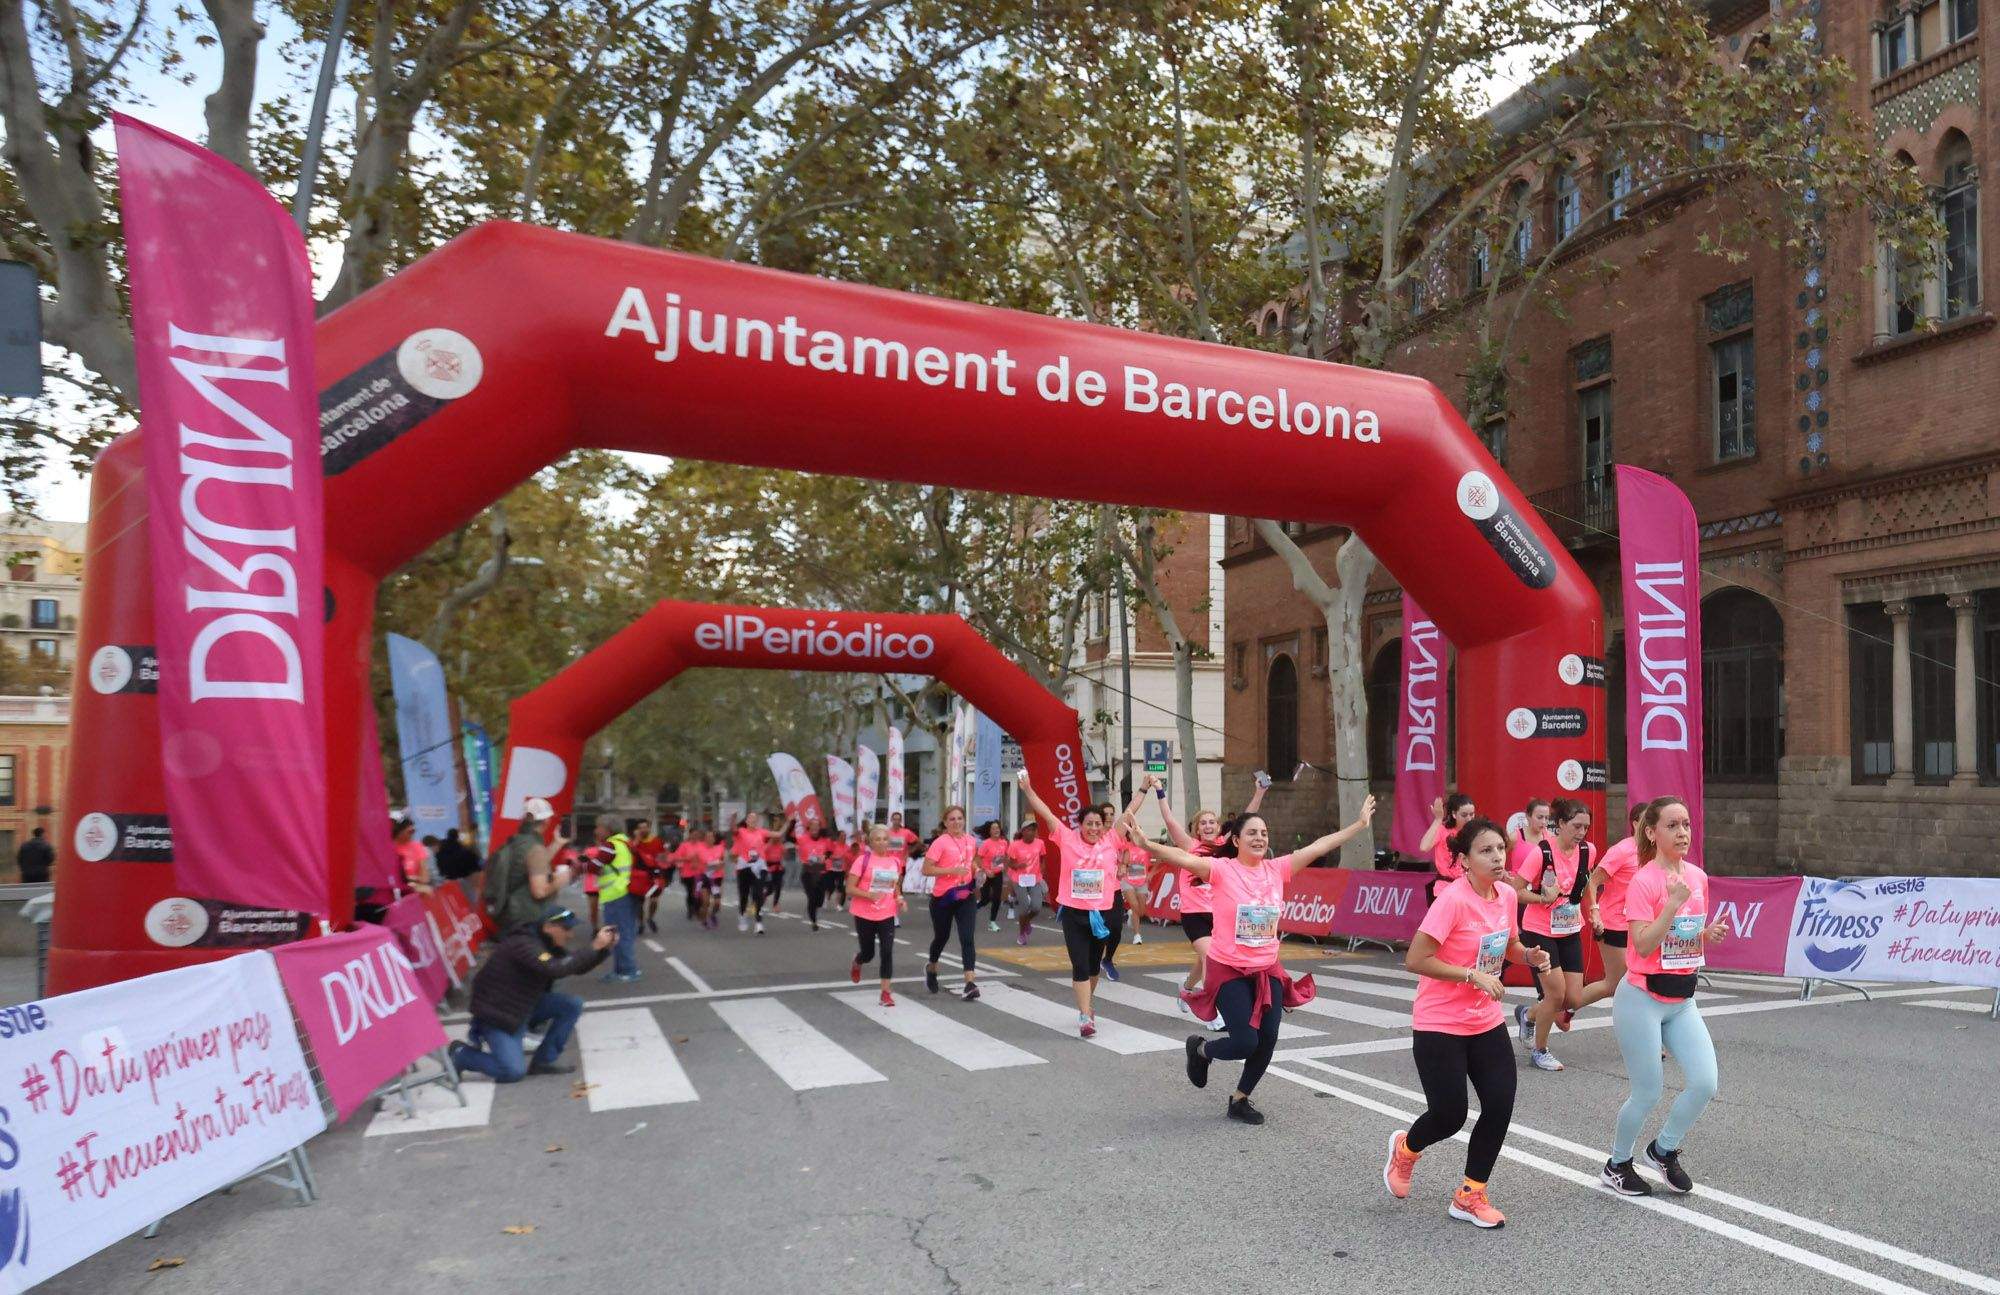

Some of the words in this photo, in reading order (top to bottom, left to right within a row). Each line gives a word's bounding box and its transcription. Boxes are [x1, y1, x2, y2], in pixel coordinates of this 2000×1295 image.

[604, 286, 1017, 396] Ajuntament
[1036, 355, 1106, 407] de
[1123, 365, 1382, 444] Barcelona
[318, 387, 374, 428] tament
[371, 377, 392, 394] de
[168, 321, 305, 705] DRUNI
[1494, 520, 1541, 577] Barcelona
[1502, 513, 1538, 558] Ajuntament
[1536, 554, 1547, 567] de
[694, 614, 935, 660] elPeriódico
[1634, 559, 1689, 752] DRUNI
[1405, 620, 1439, 771] DRUNI
[1541, 721, 1581, 730] Barcelona
[1151, 743, 1162, 759] P
[123, 837, 174, 849] Barce
[1353, 885, 1414, 916] DRUNI
[1796, 897, 1884, 939] Fitness
[218, 921, 298, 933] Barcelona
